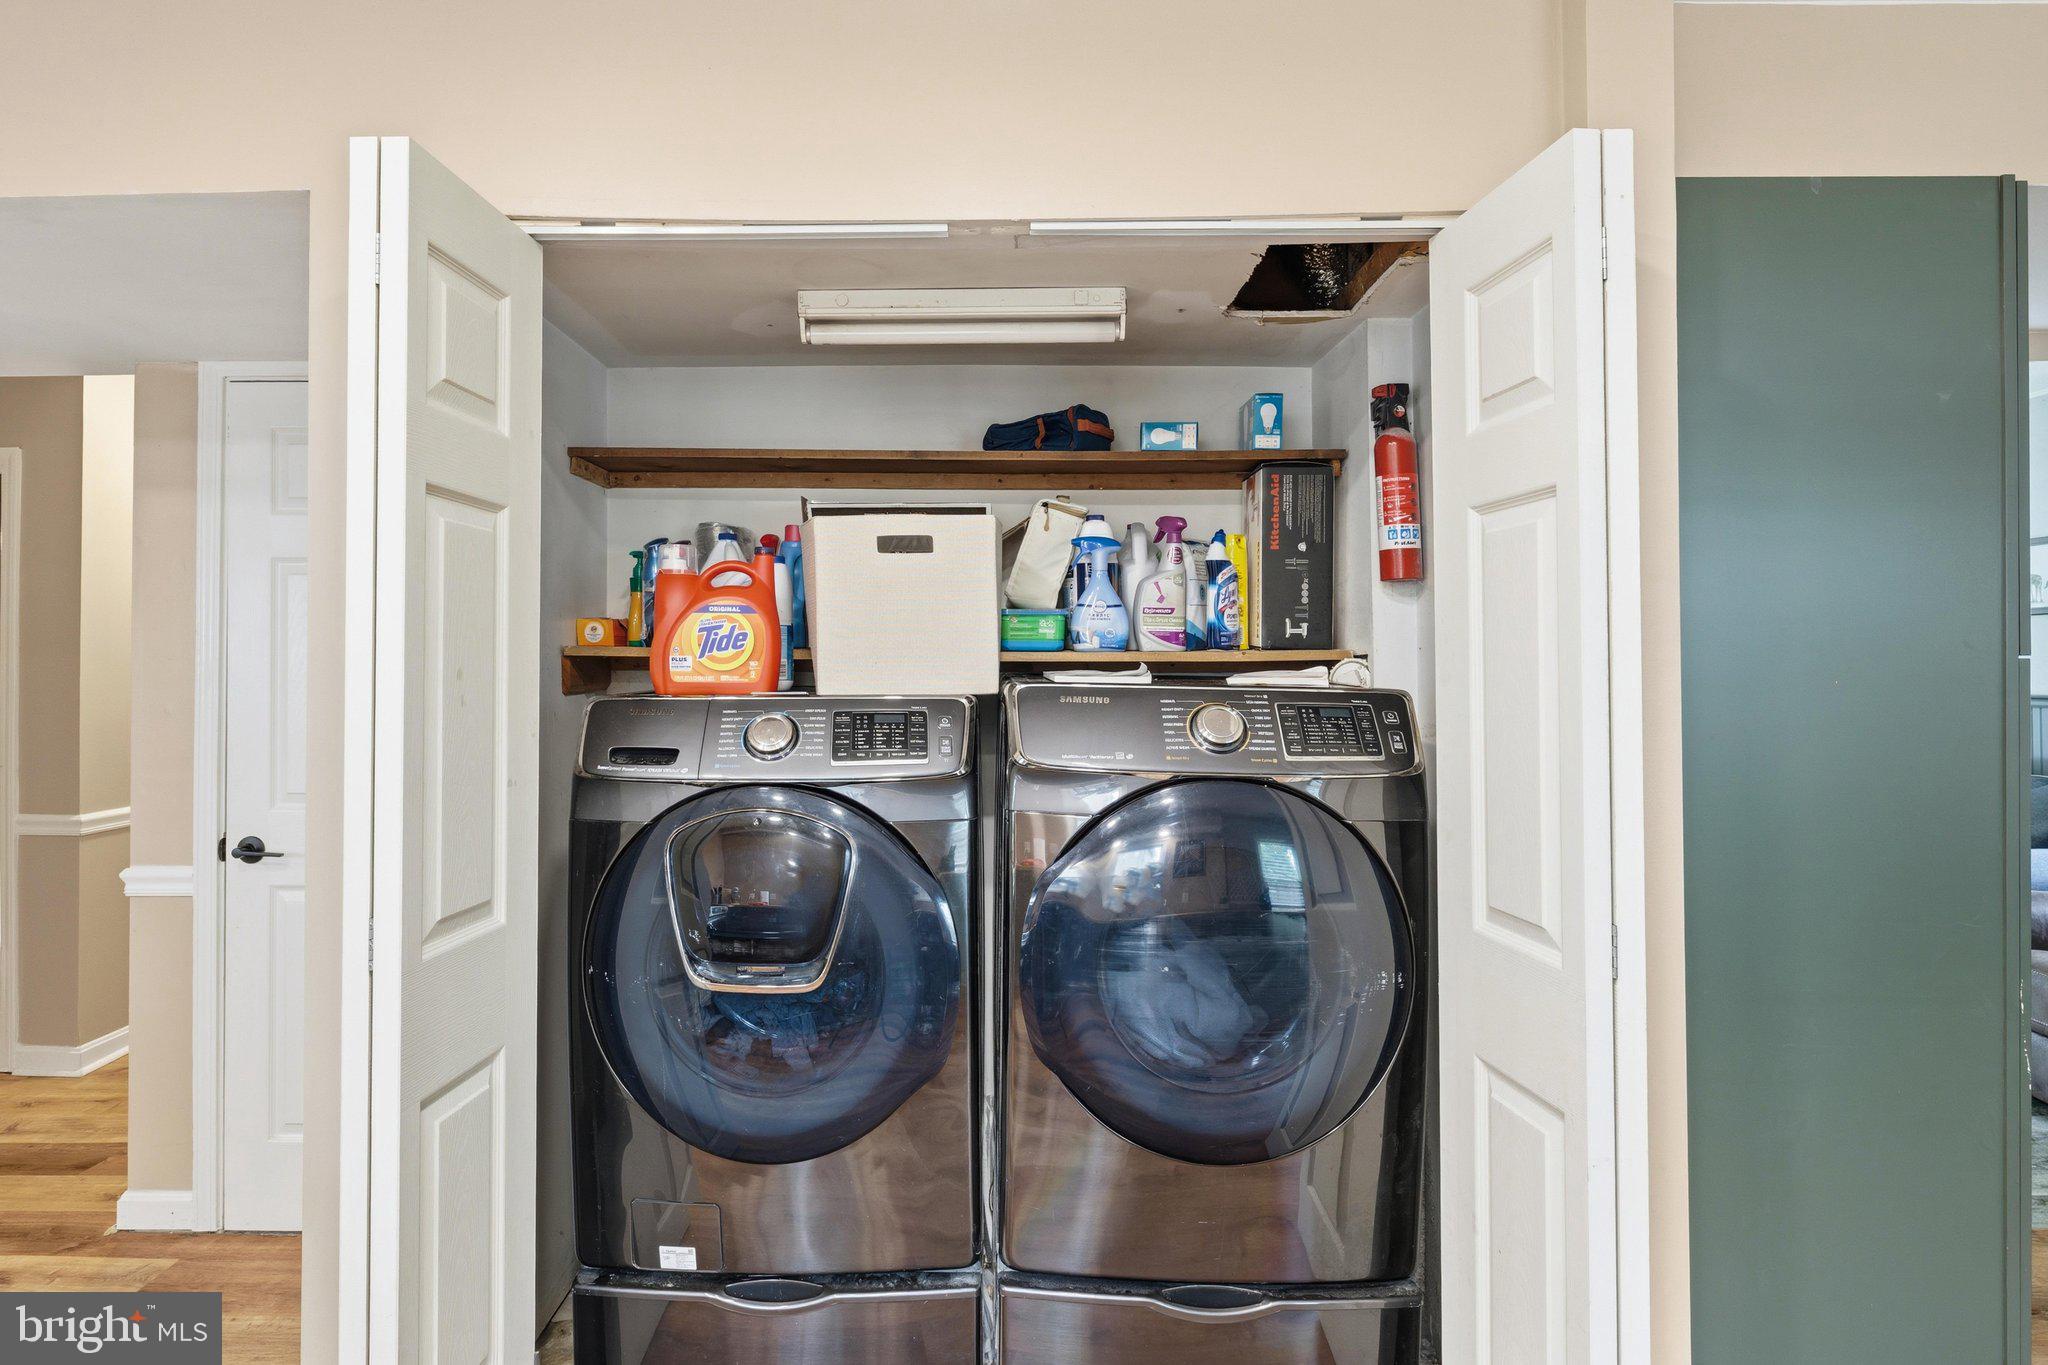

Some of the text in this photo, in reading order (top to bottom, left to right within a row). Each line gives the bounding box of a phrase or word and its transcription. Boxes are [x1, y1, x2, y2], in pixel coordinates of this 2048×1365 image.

[1269, 474, 1280, 551] KitchenAid
[698, 624, 749, 659] Tide
[1059, 695, 1110, 704] SAMSUNG
